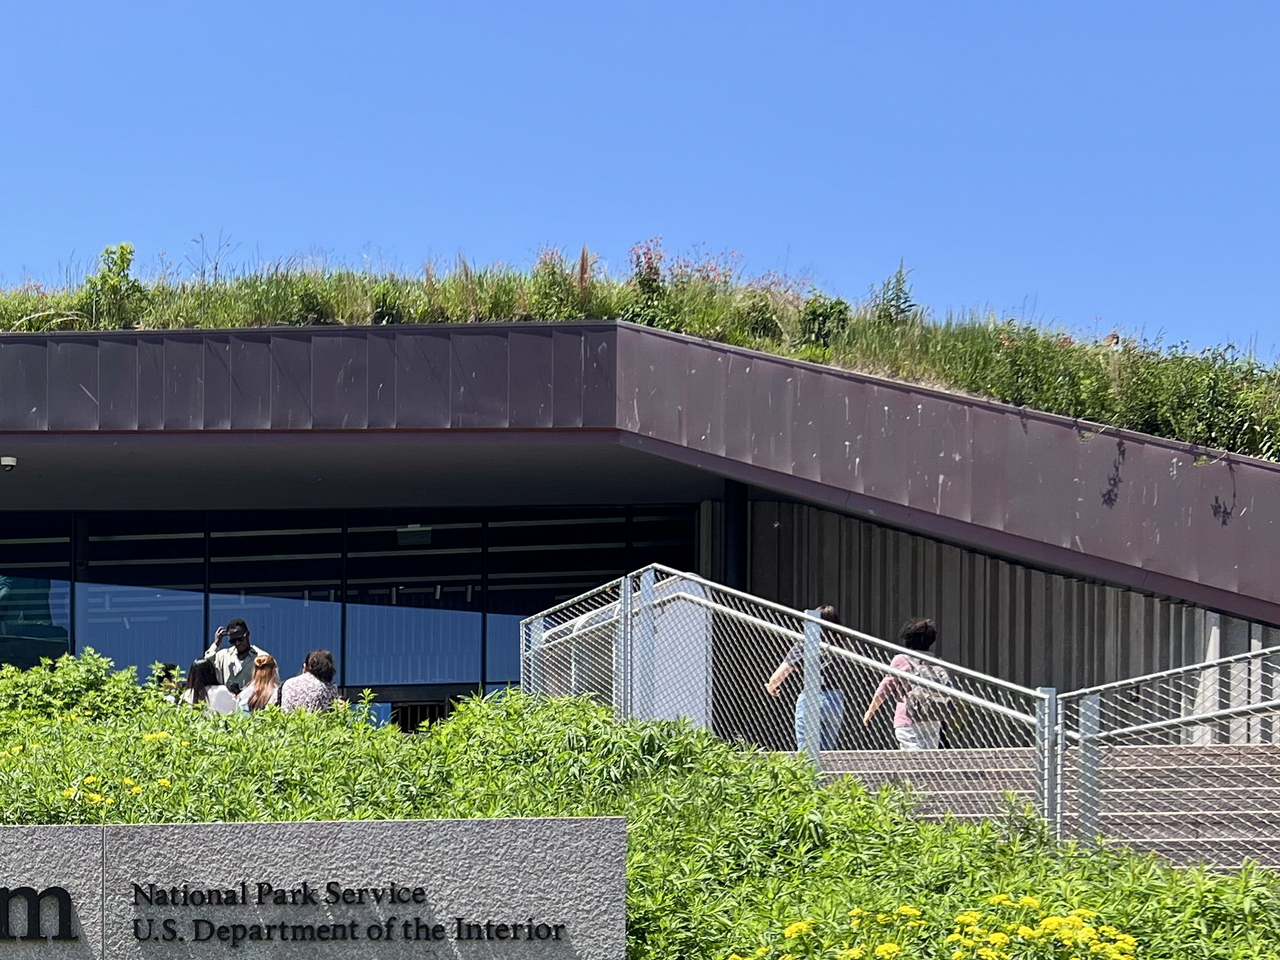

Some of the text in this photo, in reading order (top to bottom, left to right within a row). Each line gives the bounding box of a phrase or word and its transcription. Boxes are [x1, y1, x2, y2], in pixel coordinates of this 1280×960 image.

[131, 881, 426, 906] National Park Service
[132, 917, 565, 948] U.S. Department of the Interior
